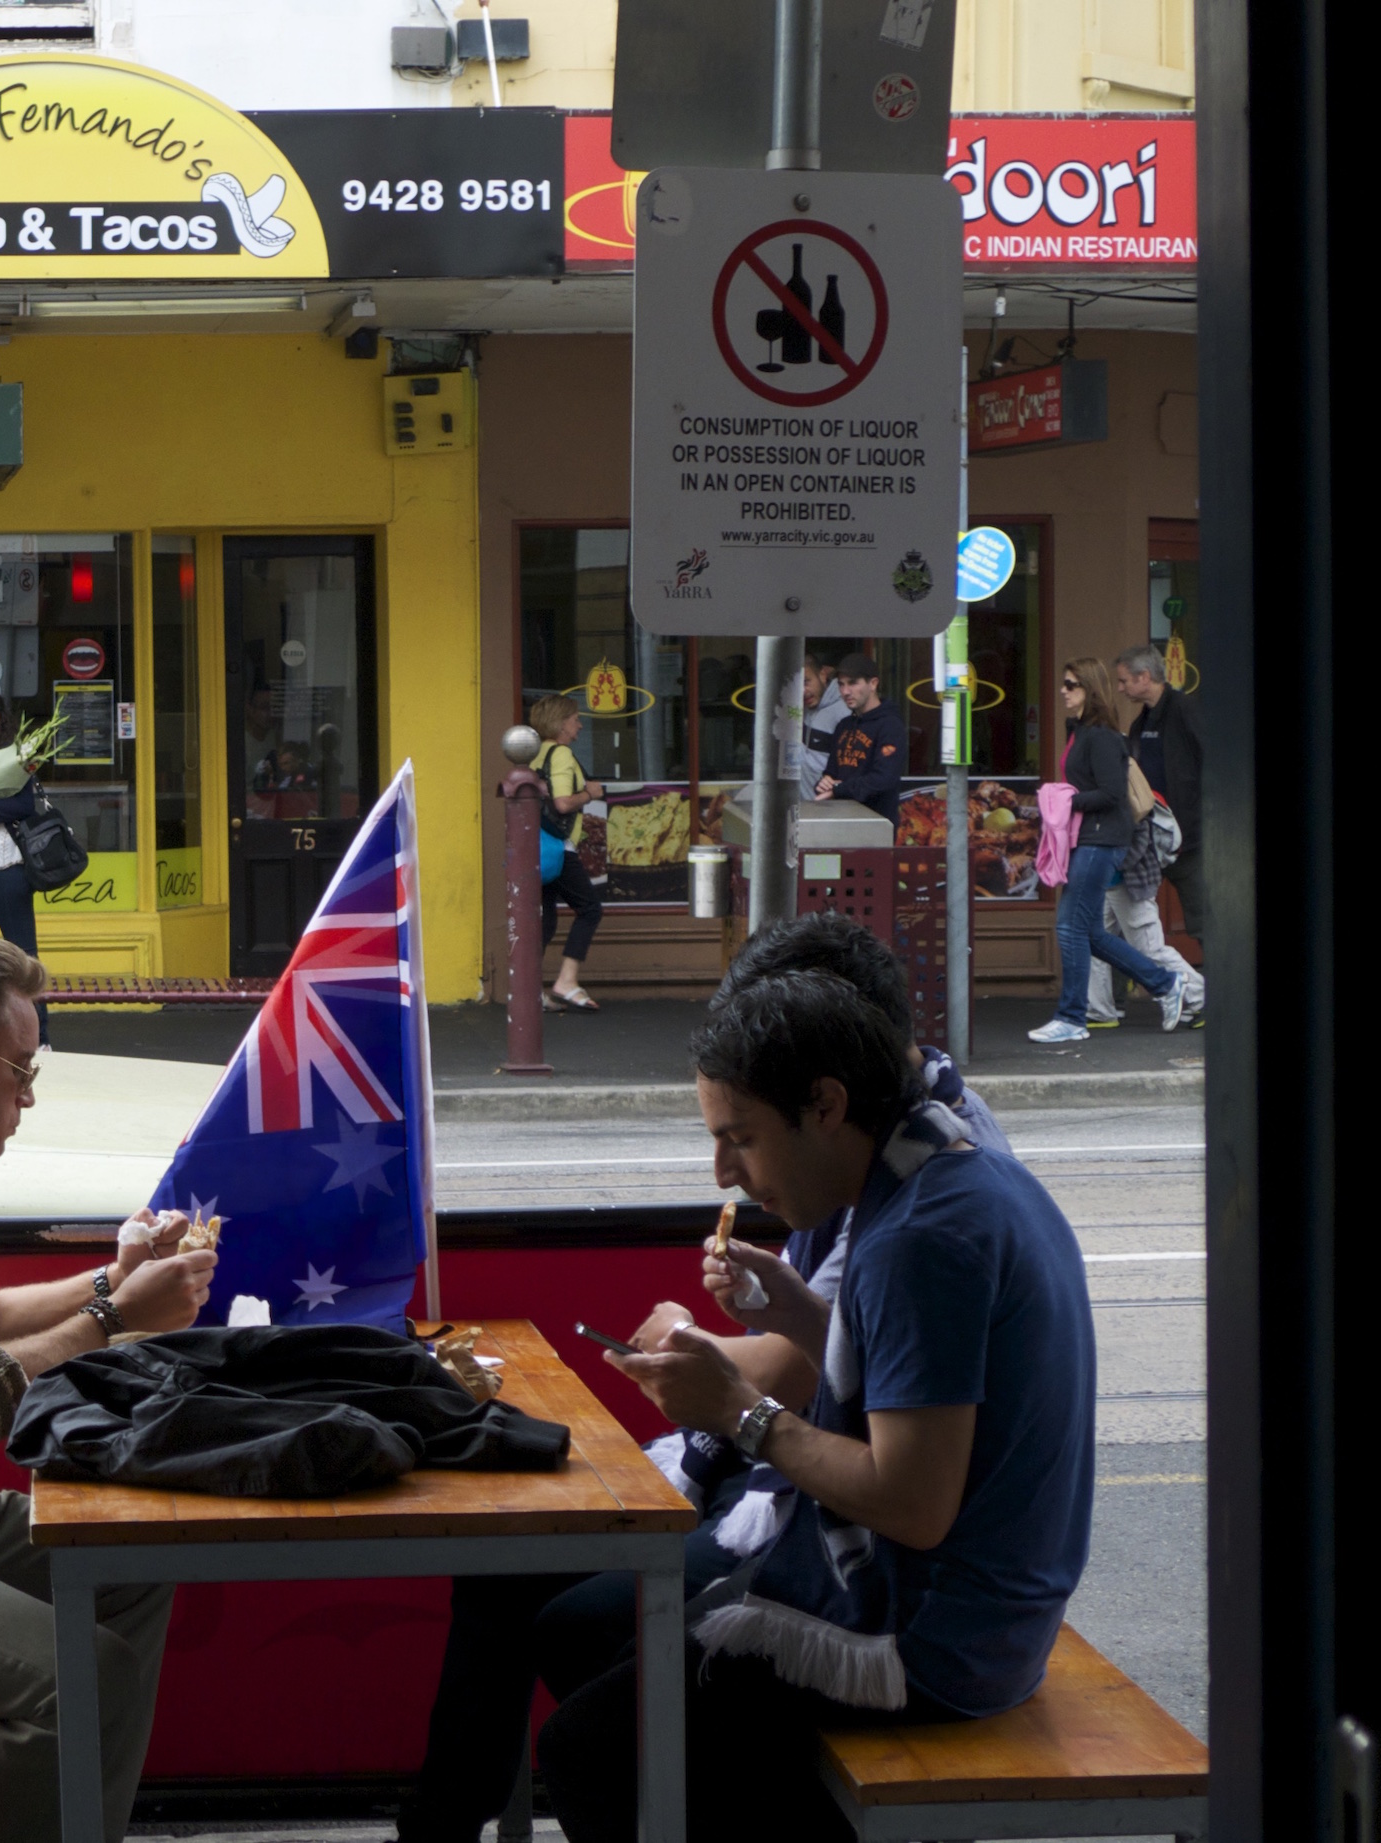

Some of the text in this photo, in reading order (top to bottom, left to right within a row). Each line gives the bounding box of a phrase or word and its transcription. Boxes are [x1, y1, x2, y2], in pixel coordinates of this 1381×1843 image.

[342, 180, 551, 212] 9428 9581
[17, 208, 56, 251] &
[70, 207, 218, 251] Tacos
[987, 236, 1062, 258] INDIAN
[680, 417, 919, 439] CONSUMPTION OF LIQUOR
[672, 445, 926, 467] OR POSSESSION OF LIQUOR
[681, 473, 916, 494] IN AN OPEN CONTAINER IS
[741, 502, 856, 521] PROHIBITED.
[721, 529, 875, 546] www.yarracity.vic.gov.au
[291, 828, 317, 851] 75
[156, 860, 198, 899] Tacos
